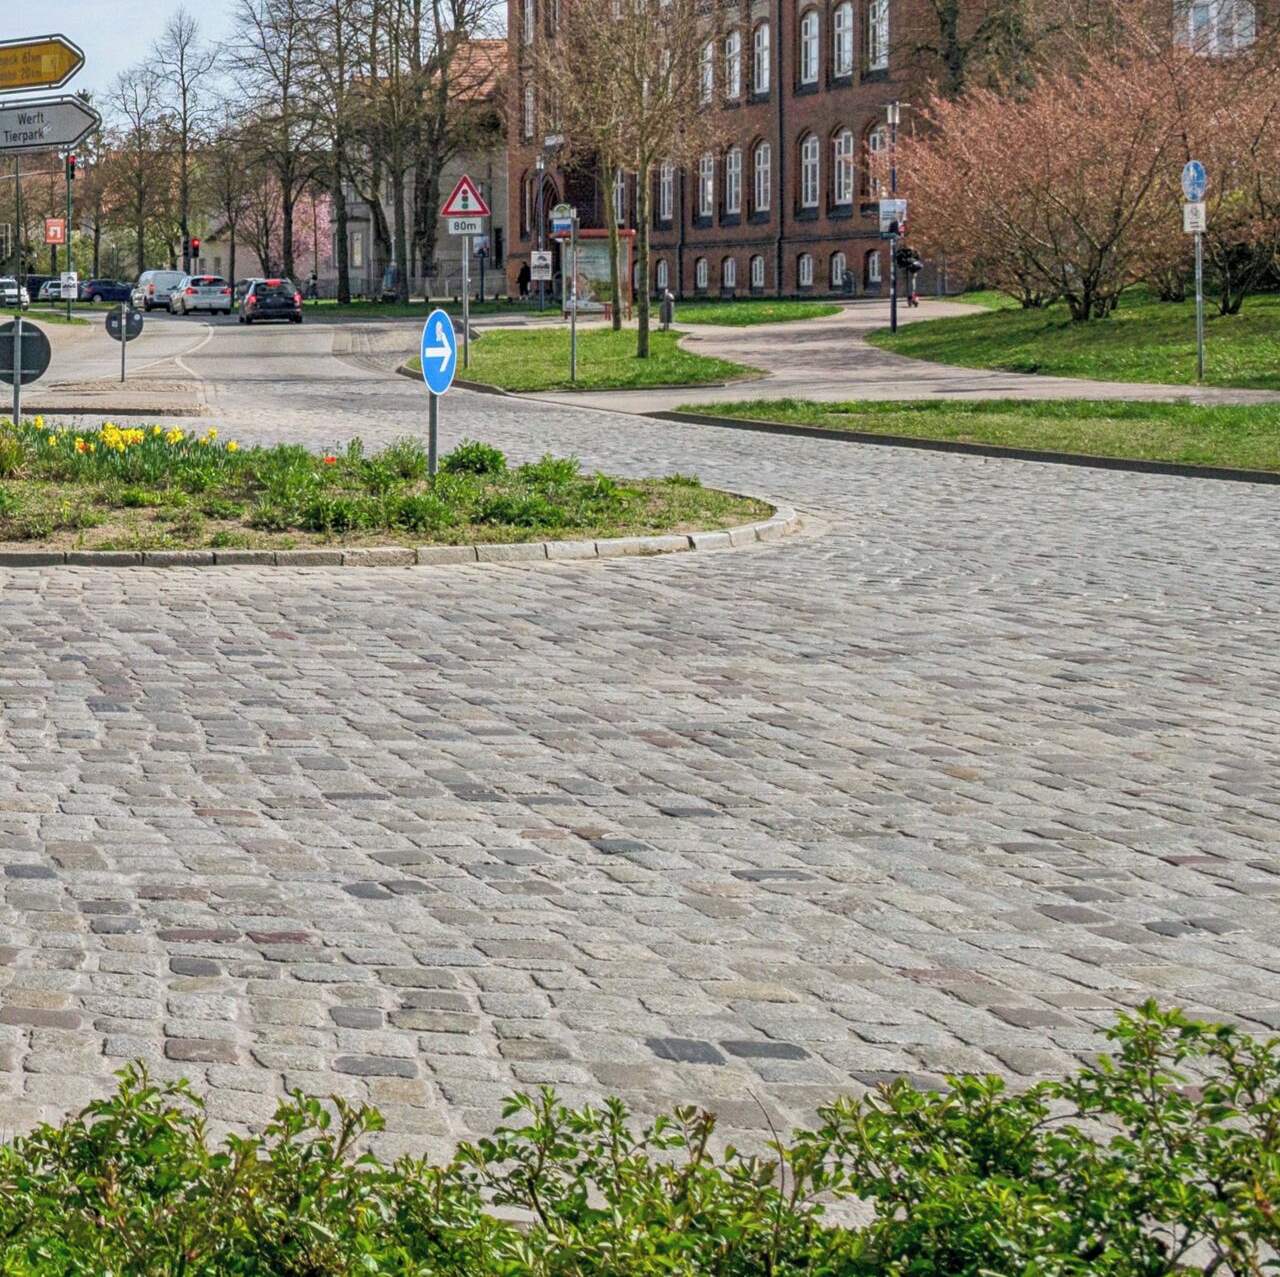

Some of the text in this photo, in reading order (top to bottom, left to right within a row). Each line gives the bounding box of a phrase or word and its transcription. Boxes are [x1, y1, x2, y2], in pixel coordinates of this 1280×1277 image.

[17, 112, 44, 126] Werft
[3, 128, 44, 144] Tierpark
[453, 221, 476, 231] 80m
